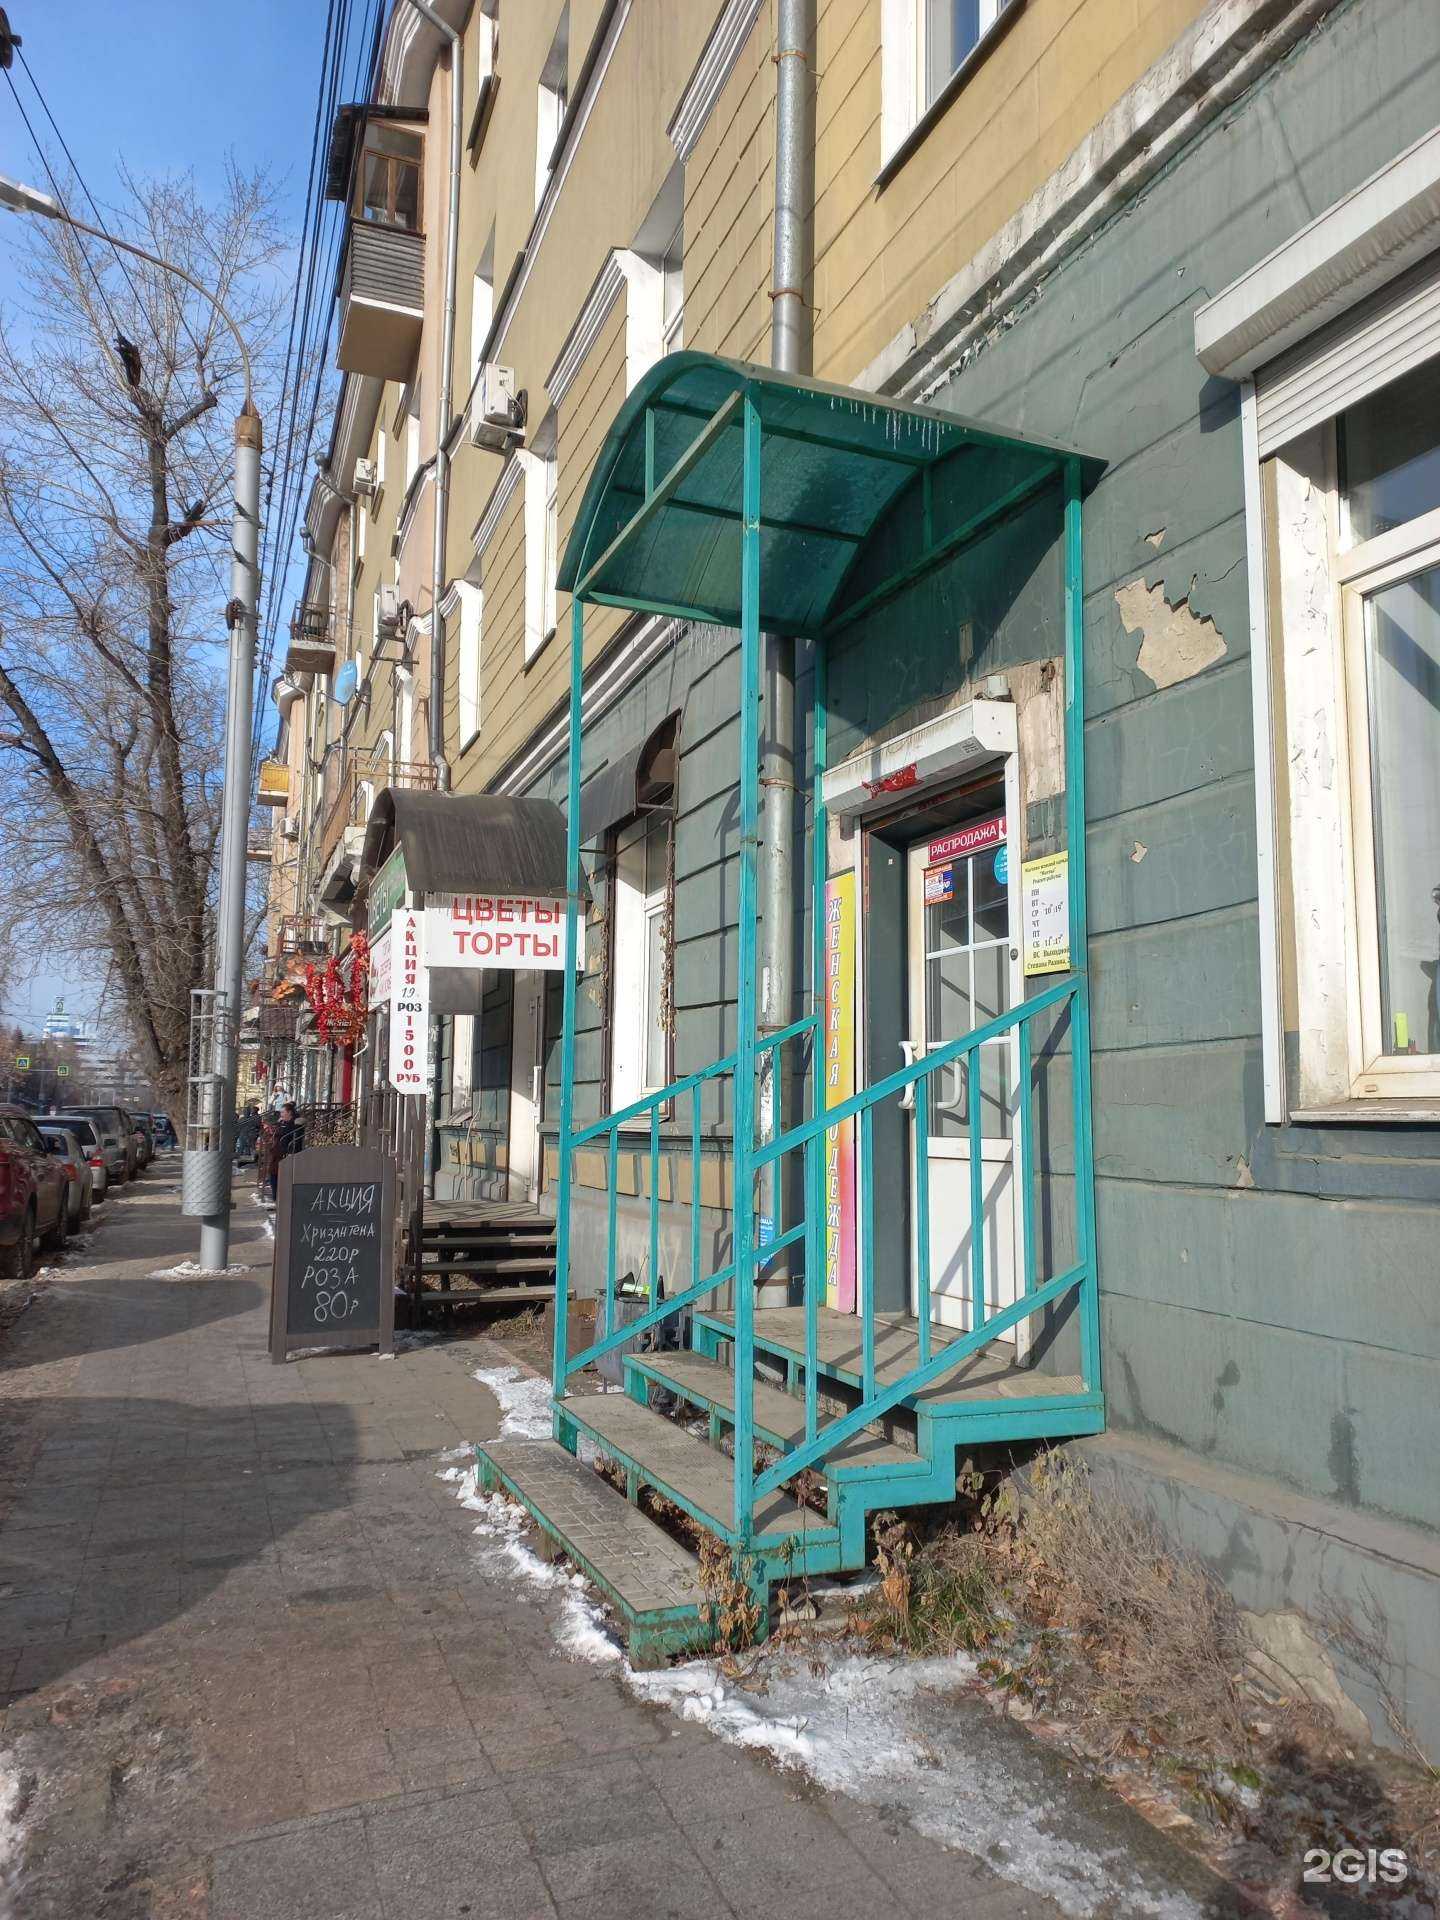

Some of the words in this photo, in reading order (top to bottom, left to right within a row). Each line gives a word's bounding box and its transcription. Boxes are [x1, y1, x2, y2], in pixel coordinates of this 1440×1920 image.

[931, 824, 997, 856] РАСПРОДАЖА
[452, 897, 560, 924] ЦВЕТЫ
[405, 916, 417, 985] АКЦИЯ
[453, 931, 558, 957] ТОРТЫ
[397, 1002, 422, 1013] РОЗ
[827, 897, 842, 1087] ЖЕНСКАЯ
[404, 1015, 414, 1070] 1500
[396, 1073, 421, 1084] РУБ
[310, 1184, 376, 1216] АКЦИЯ
